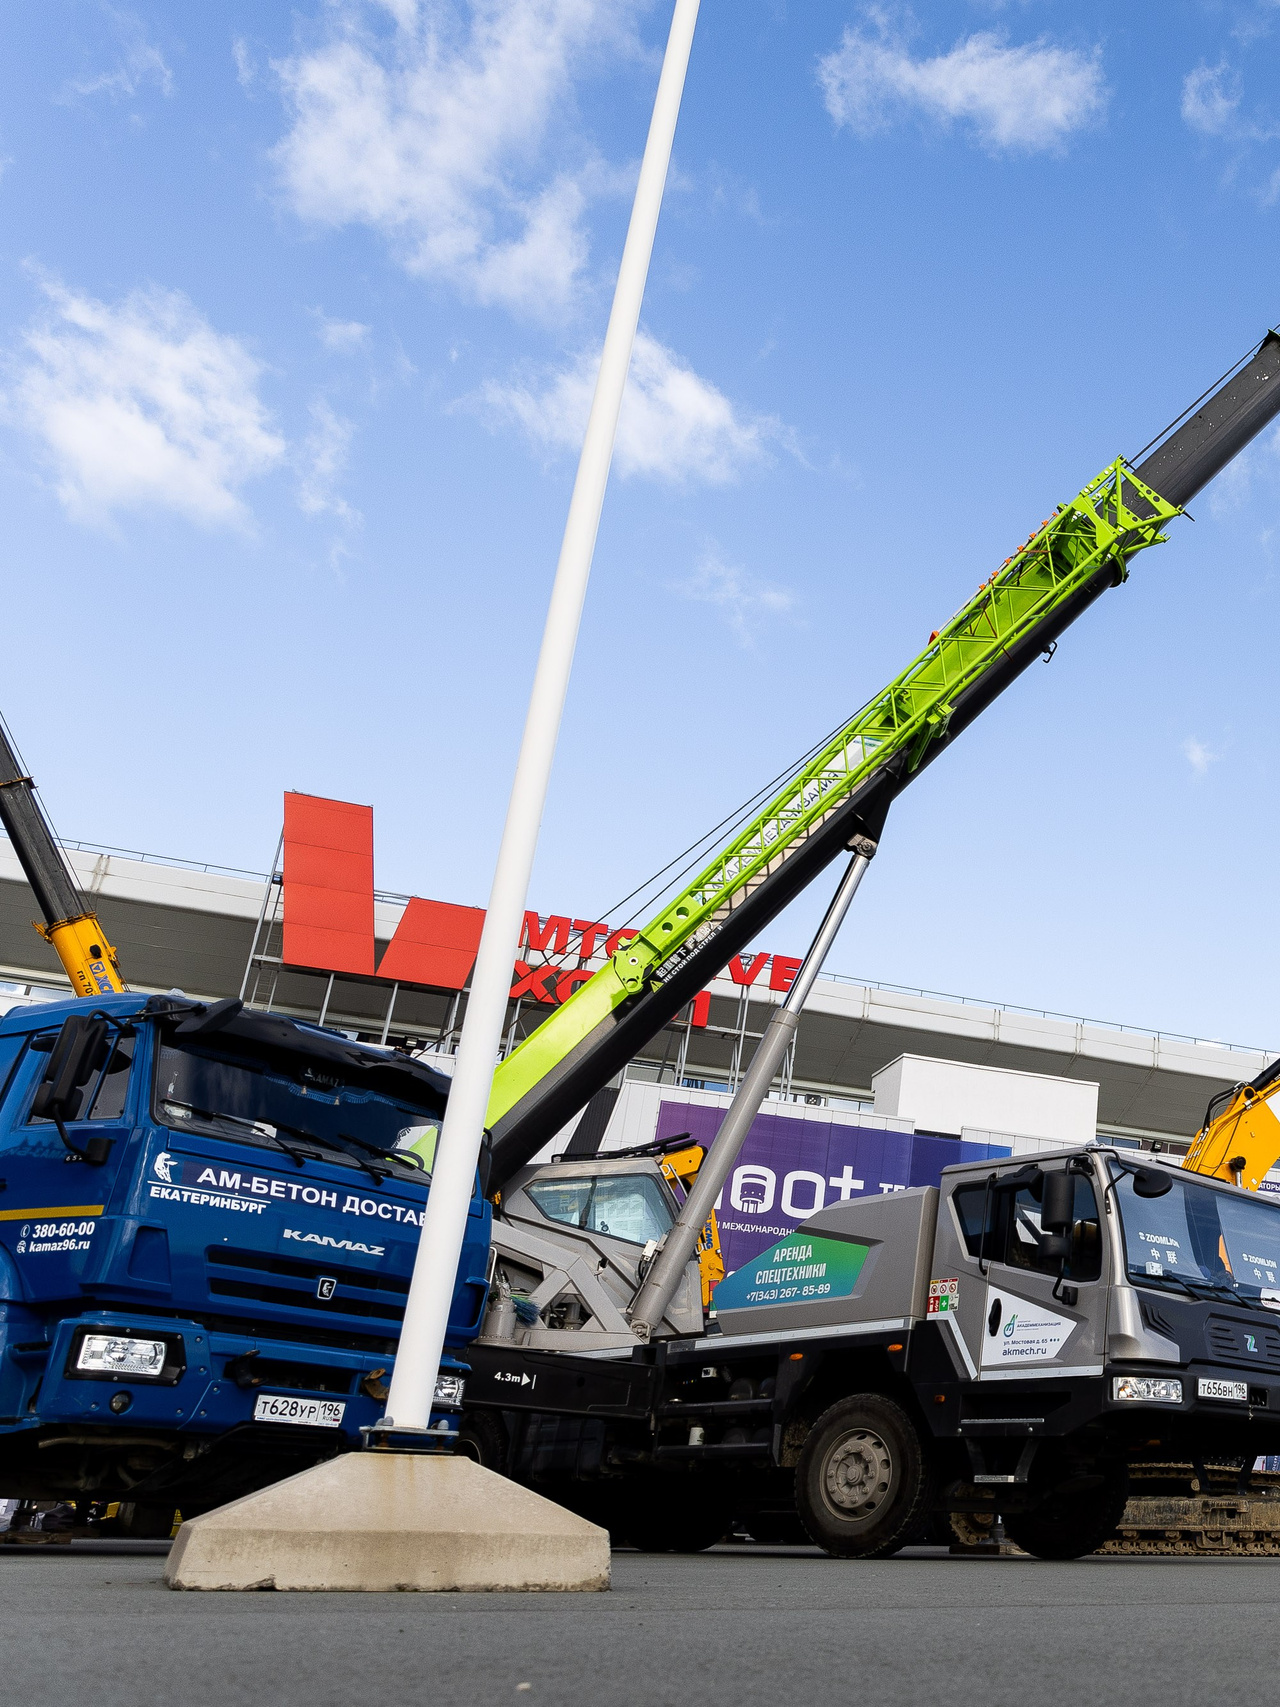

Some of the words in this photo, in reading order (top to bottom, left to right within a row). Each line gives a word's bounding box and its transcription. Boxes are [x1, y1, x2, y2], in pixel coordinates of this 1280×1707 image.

[671, 959, 688, 976] СТОЙ
[697, 924, 724, 951] СТРЕЛЙ
[197, 1167, 337, 1208] АМ-БЕТОН
[150, 1186, 267, 1214] ЕКАТЕРИНБУРГ
[32, 1221, 95, 1239] 380-60-00
[29, 1239, 90, 1252] kamaz96.ru
[283, 1228, 385, 1256] KAMAZ
[1146, 1234, 1180, 1248] ZOOMLION
[773, 1244, 812, 1262] АРЕНДА
[1248, 1254, 1277, 1269] ZOOMLION
[755, 1263, 827, 1285] СПЕЦТЕХНИКИ
[746, 1288, 778, 1302] +7(343)
[802, 1283, 831, 1296] 85-89
[1002, 1347, 1047, 1356] akmech.ru
[494, 1372, 521, 1383] 4.3m
[321, 1403, 341, 1417] 196
